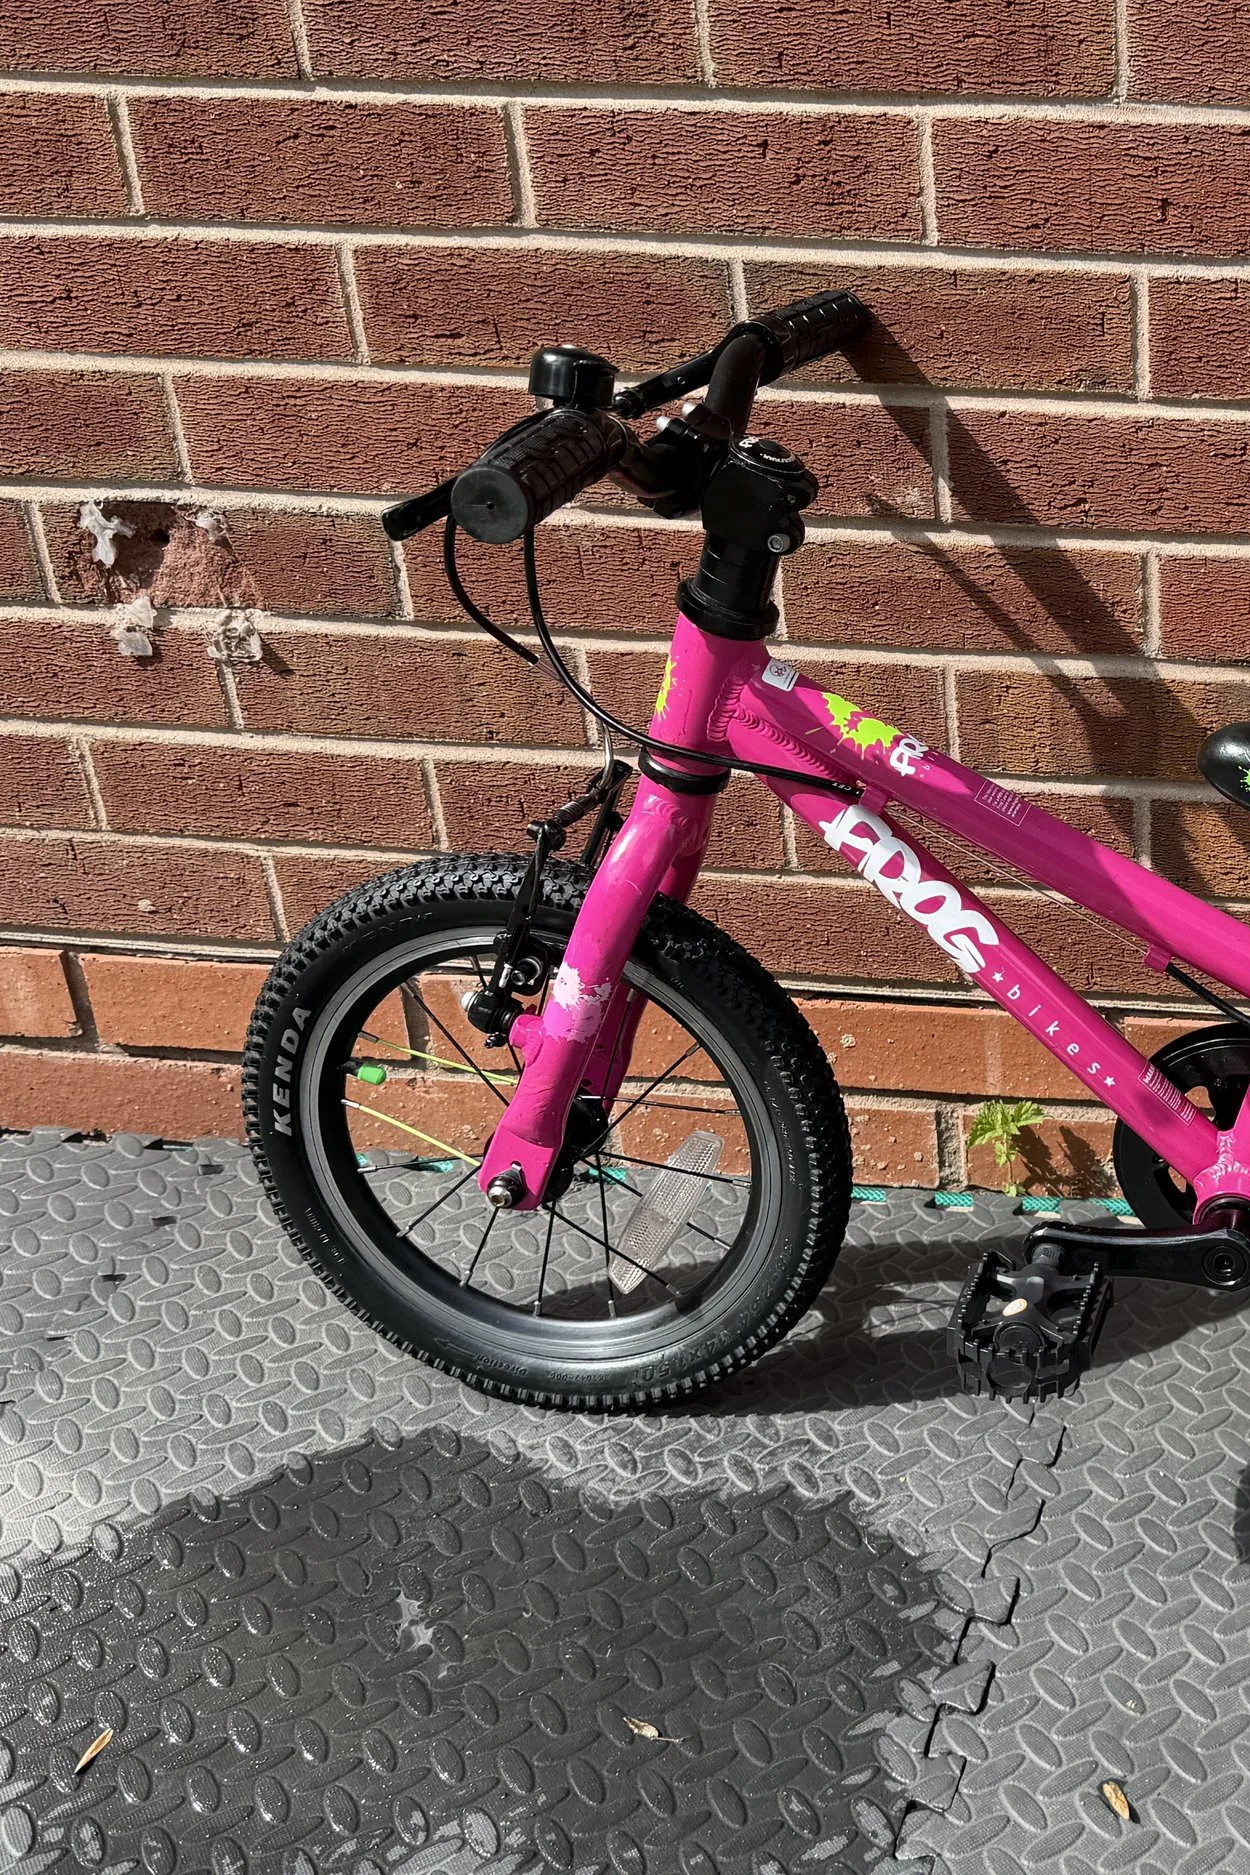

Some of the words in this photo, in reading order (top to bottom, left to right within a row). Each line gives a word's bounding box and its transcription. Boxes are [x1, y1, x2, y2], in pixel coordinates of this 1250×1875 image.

[818, 803, 1000, 974] FROG
[273, 1006, 313, 1137] KENDA
[1005, 983, 1103, 1076] bikes
[474, 1353, 529, 1377] Direction
